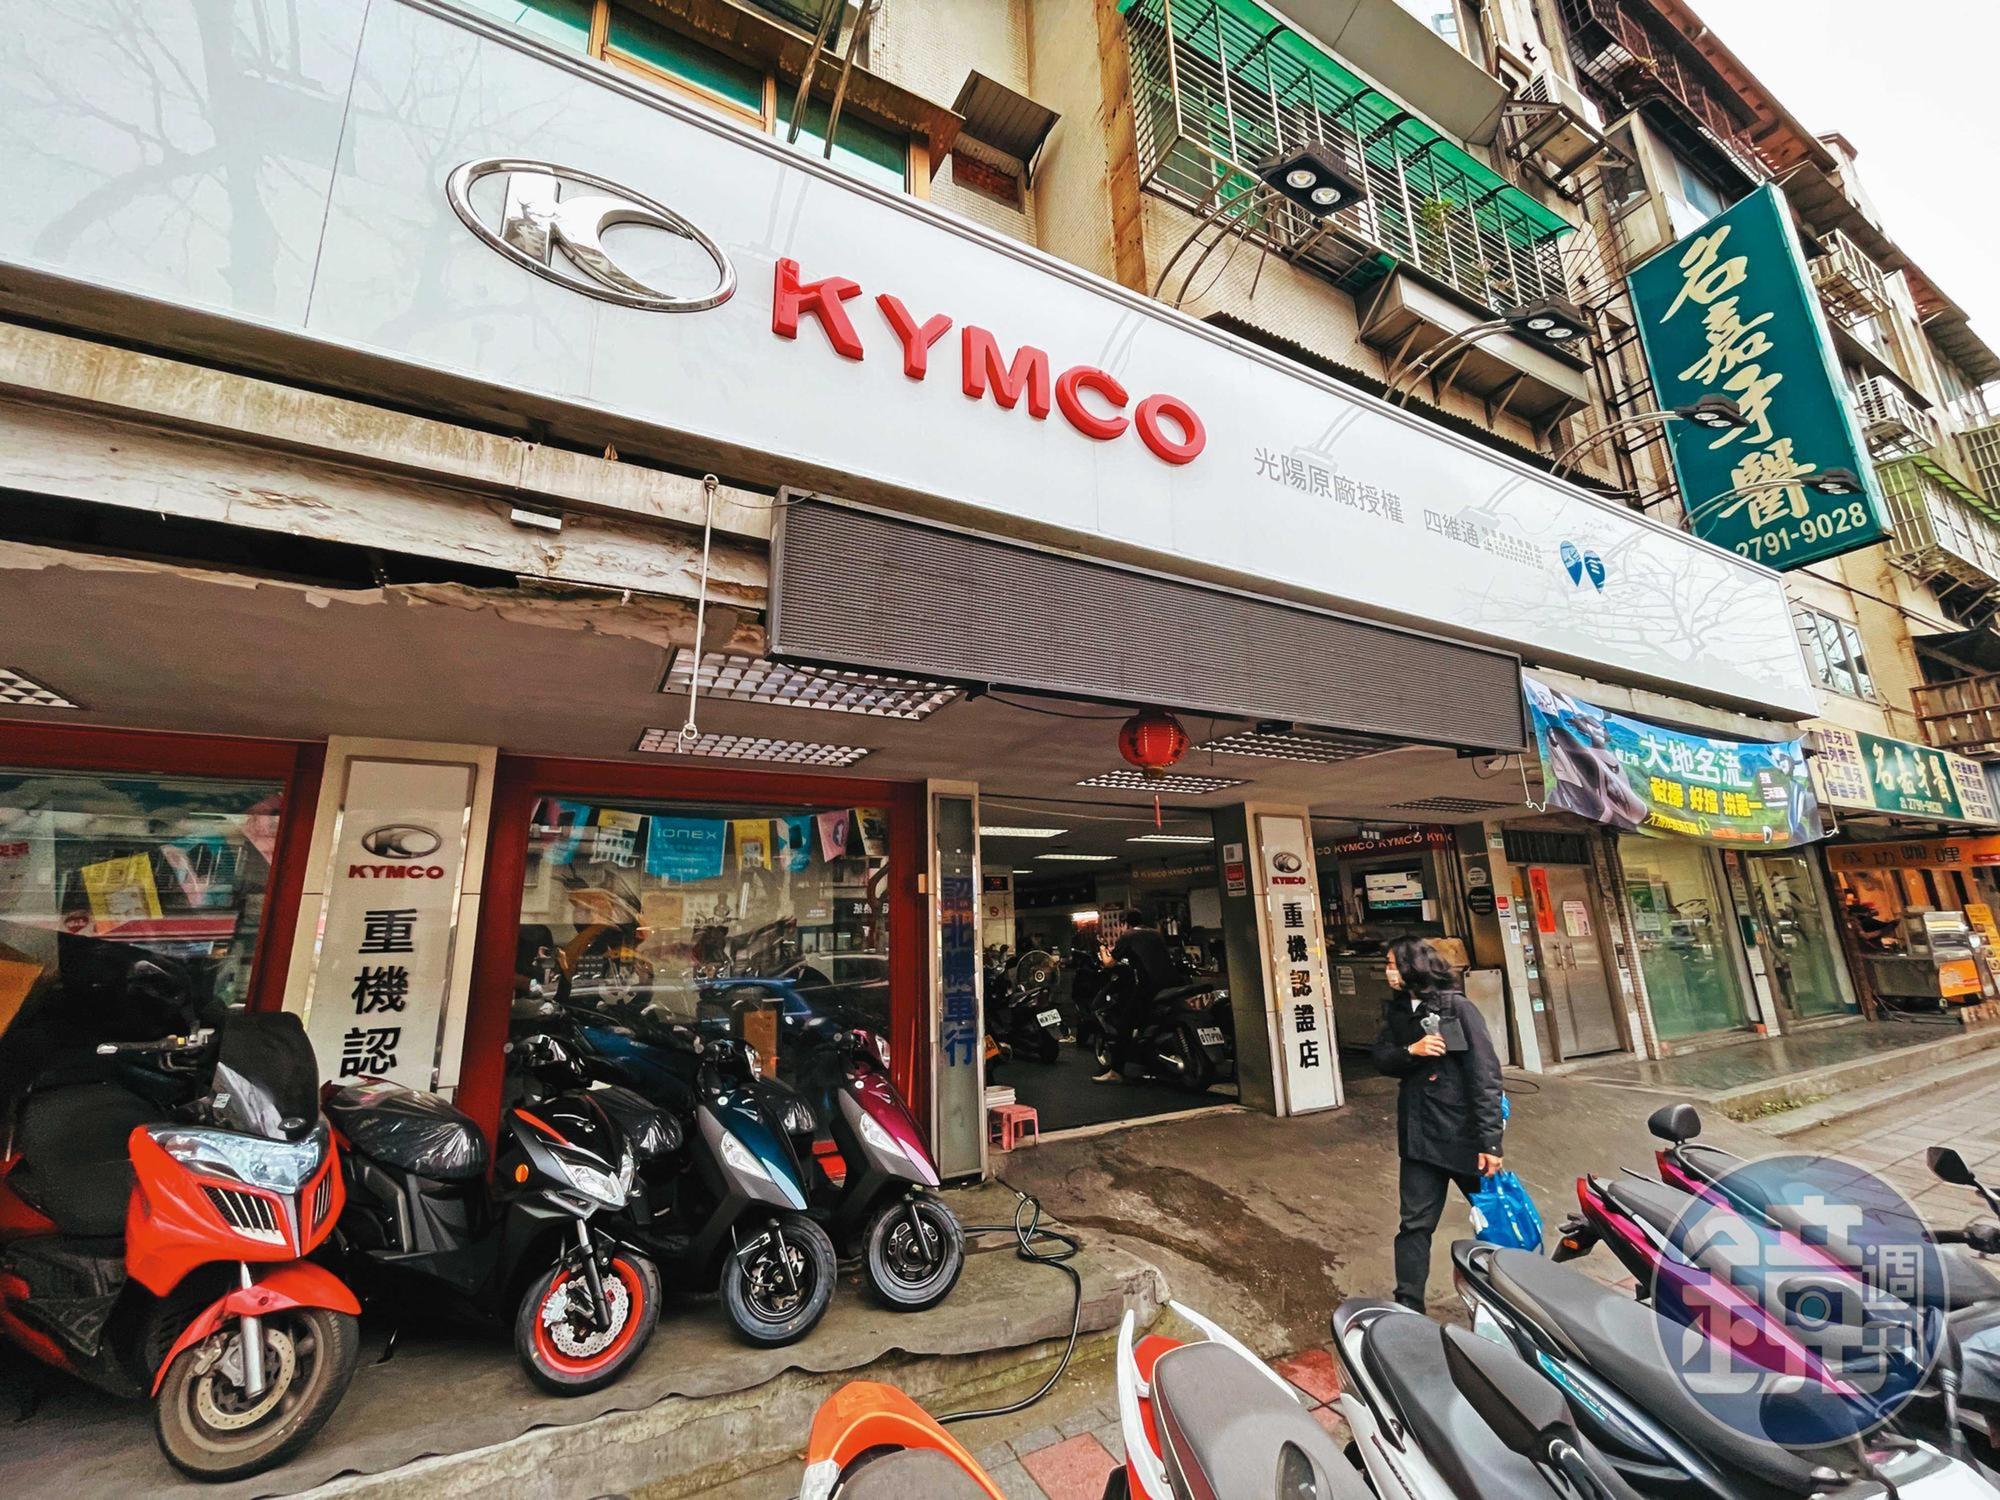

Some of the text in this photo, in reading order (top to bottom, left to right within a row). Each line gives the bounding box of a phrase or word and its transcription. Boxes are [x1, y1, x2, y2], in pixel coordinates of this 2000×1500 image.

[772, 257, 1207, 465] KYMCO
[1254, 447, 1405, 524] 光陽原廠授權
[1423, 508, 1480, 549] 四維通
[1735, 502, 1867, 561] 2791-9028
[1640, 734, 1753, 788] 大地名流
[1334, 840, 1375, 853] KYMCO
[1378, 832, 1423, 848] KYMCO
[348, 864, 444, 881] KYMCO
[1271, 876, 1306, 885] KYMCO
[339, 908, 418, 1078] 重機認
[1282, 902, 1320, 1069] 重機認證店
